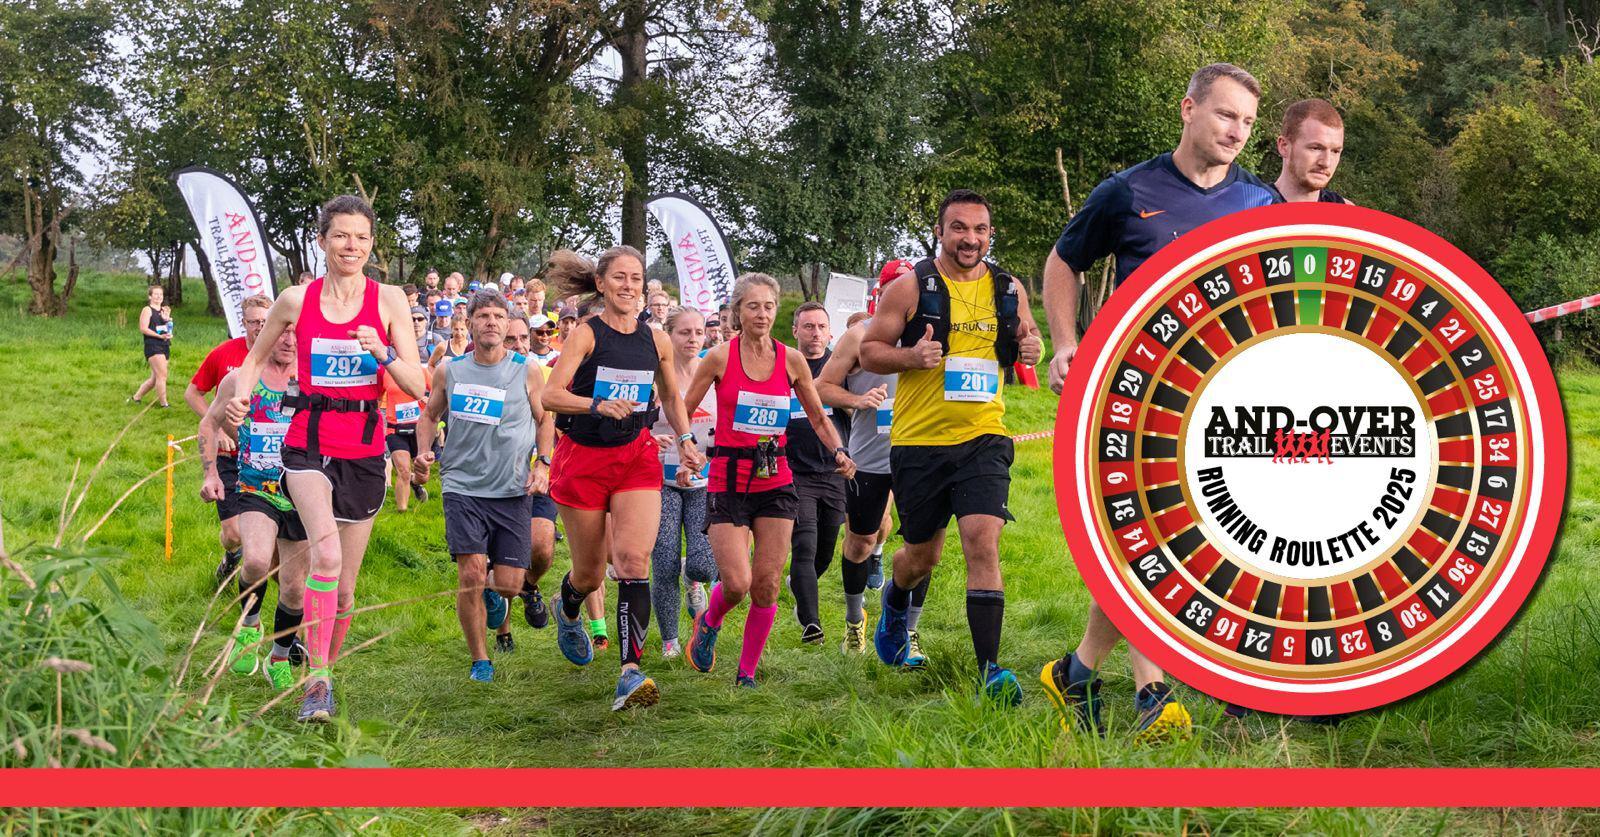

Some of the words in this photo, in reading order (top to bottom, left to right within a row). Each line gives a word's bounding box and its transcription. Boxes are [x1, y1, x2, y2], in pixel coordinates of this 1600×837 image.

[208, 215, 229, 259] TRAIL
[225, 210, 266, 296] AND-O
[326, 356, 362, 376] 292
[961, 373, 988, 391] 201
[608, 384, 639, 401] 288
[463, 397, 490, 414] 227
[748, 407, 778, 426] 289
[262, 436, 286, 452] 25
